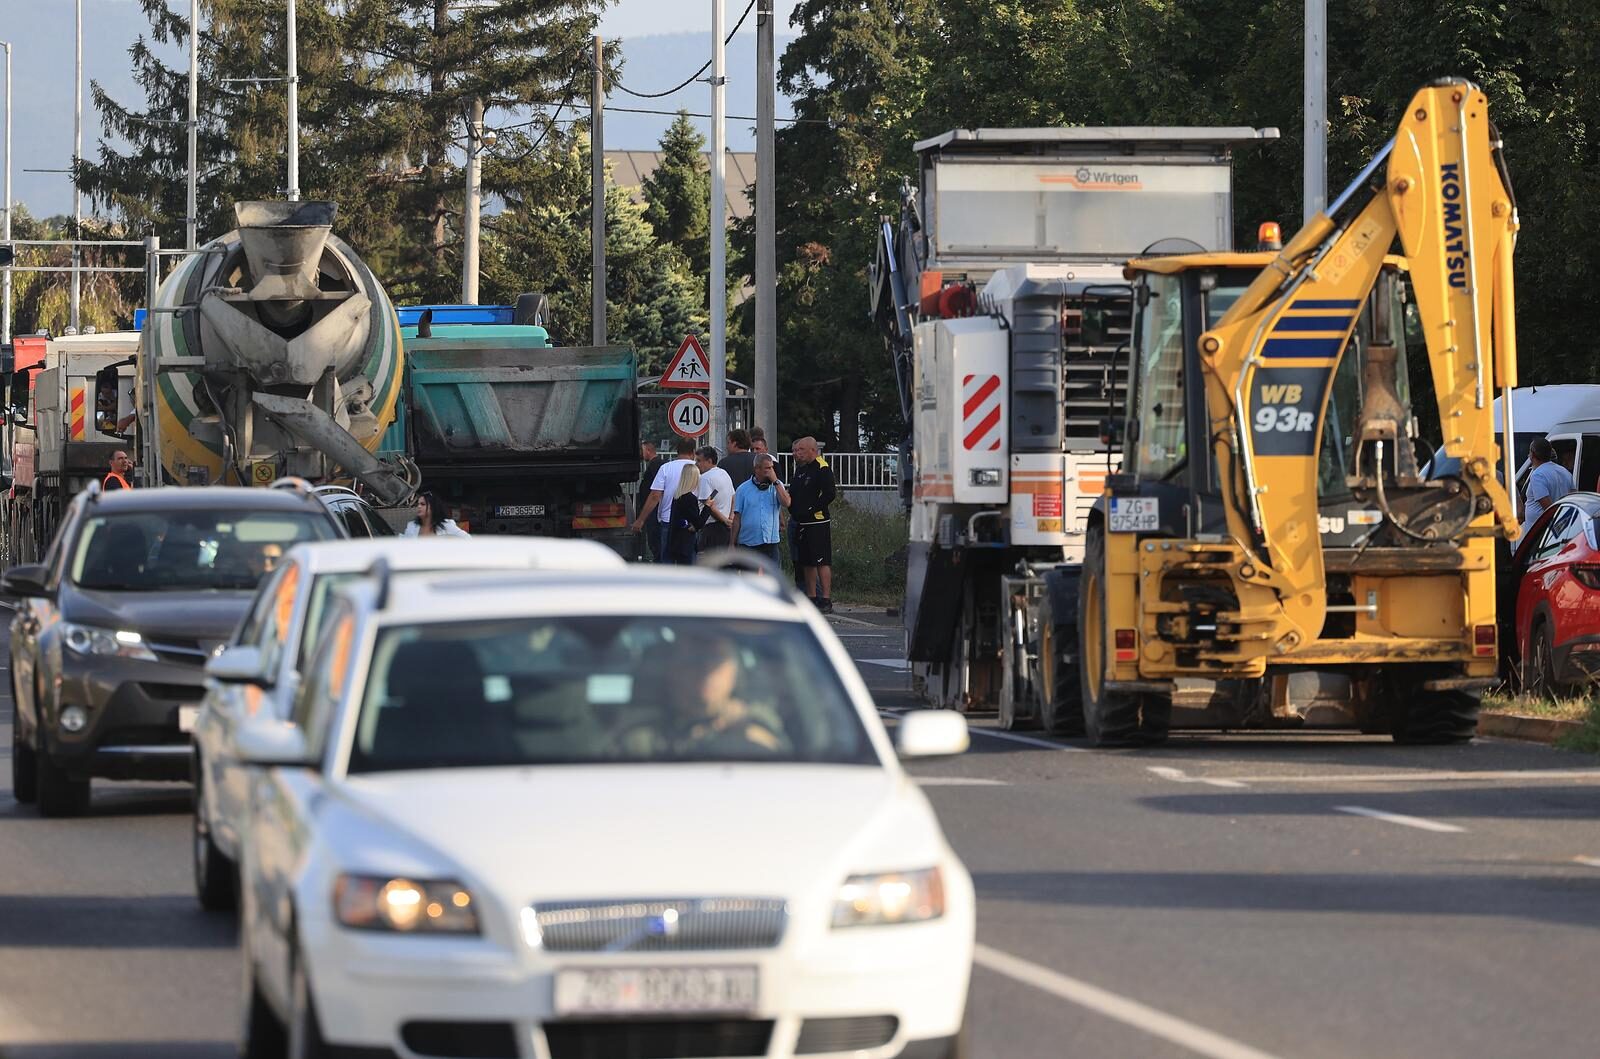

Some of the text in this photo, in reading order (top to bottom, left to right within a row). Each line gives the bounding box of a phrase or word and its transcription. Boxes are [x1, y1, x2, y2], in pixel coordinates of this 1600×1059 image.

[1093, 172, 1138, 185] Wirtgen
[1441, 164, 1468, 288] KOMATSU
[1261, 384, 1302, 404] WB
[679, 405, 703, 426] 40
[1254, 406, 1314, 432] 93R
[1126, 500, 1143, 514] ZG
